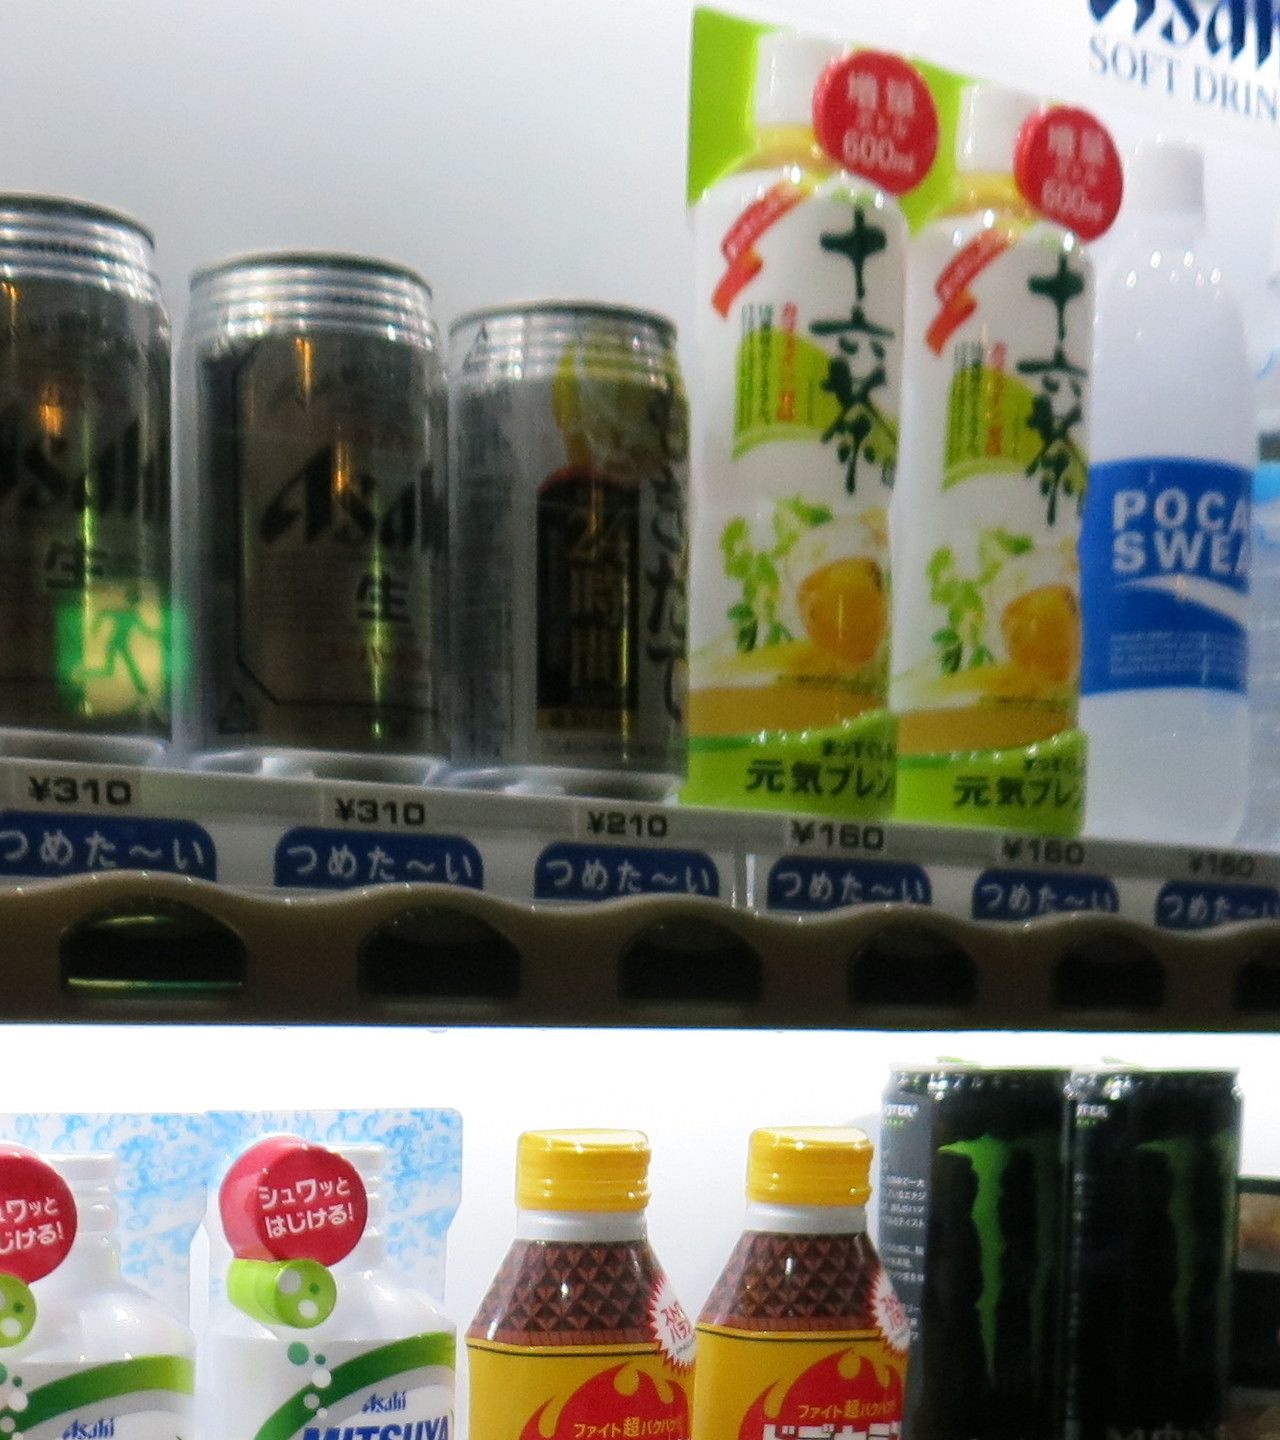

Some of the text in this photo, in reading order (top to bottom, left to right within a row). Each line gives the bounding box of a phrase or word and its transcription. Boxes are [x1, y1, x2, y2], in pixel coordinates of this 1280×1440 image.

[1089, 35, 1182, 92] SOFT
[809, 204, 895, 494] 十六茶
[28, 777, 131, 805] ¥310
[336, 799, 425, 825] ¥310
[587, 812, 668, 837] ¥210
[792, 821, 884, 850] ¥160
[258, 1176, 352, 1211] シュワッと
[362, 1391, 407, 1414] Asahi
[62, 1417, 115, 1440] Asahi
